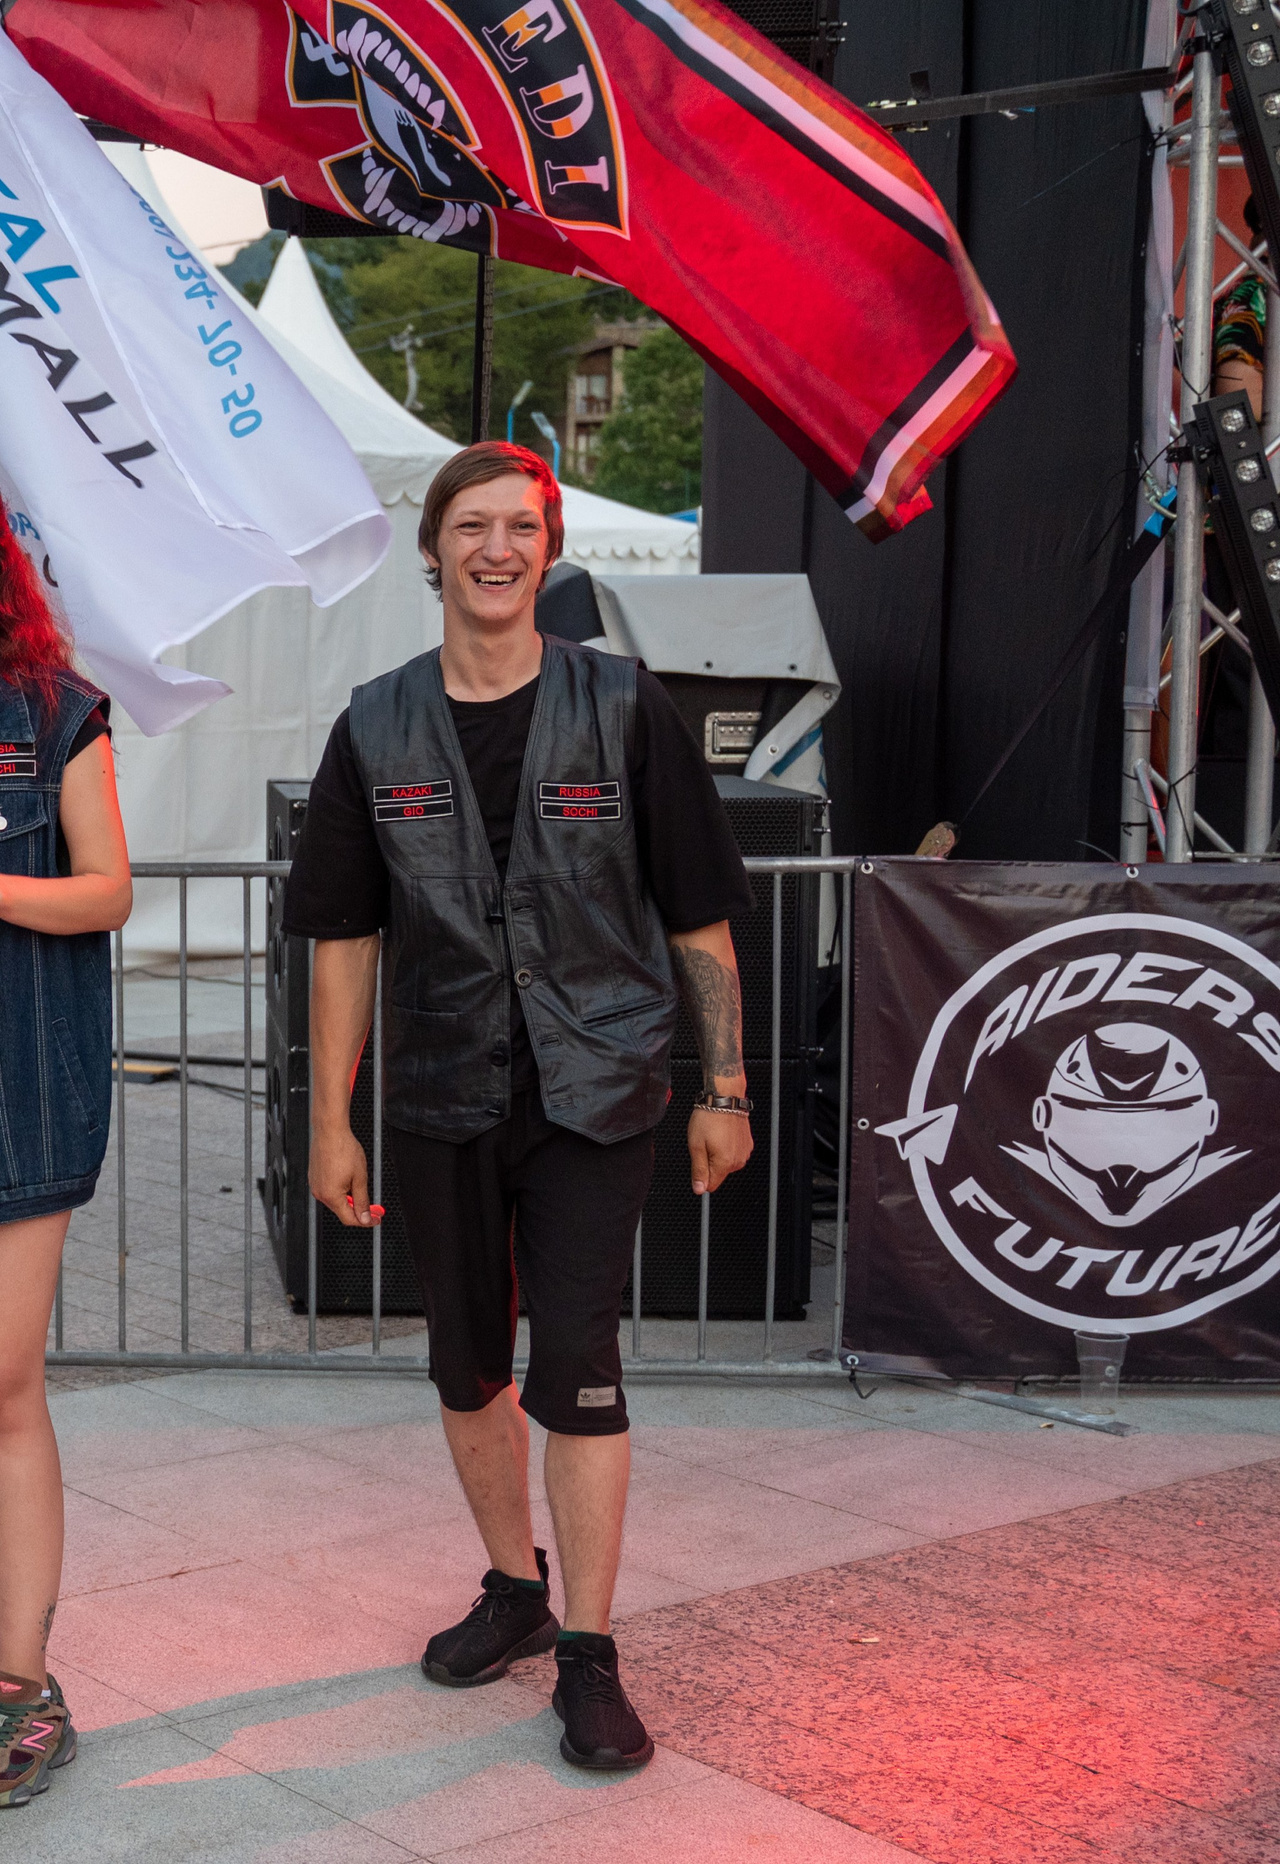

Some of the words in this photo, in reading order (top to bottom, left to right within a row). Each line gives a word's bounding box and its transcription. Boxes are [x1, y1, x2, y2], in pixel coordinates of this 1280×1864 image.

[392, 785, 432, 798] KAZAKI
[559, 787, 601, 798] RUSSIA
[403, 805, 424, 817] GIO
[562, 806, 598, 817] SOCHI
[963, 951, 1280, 1095] RIDERS
[950, 1176, 1280, 1297] FUTURE
